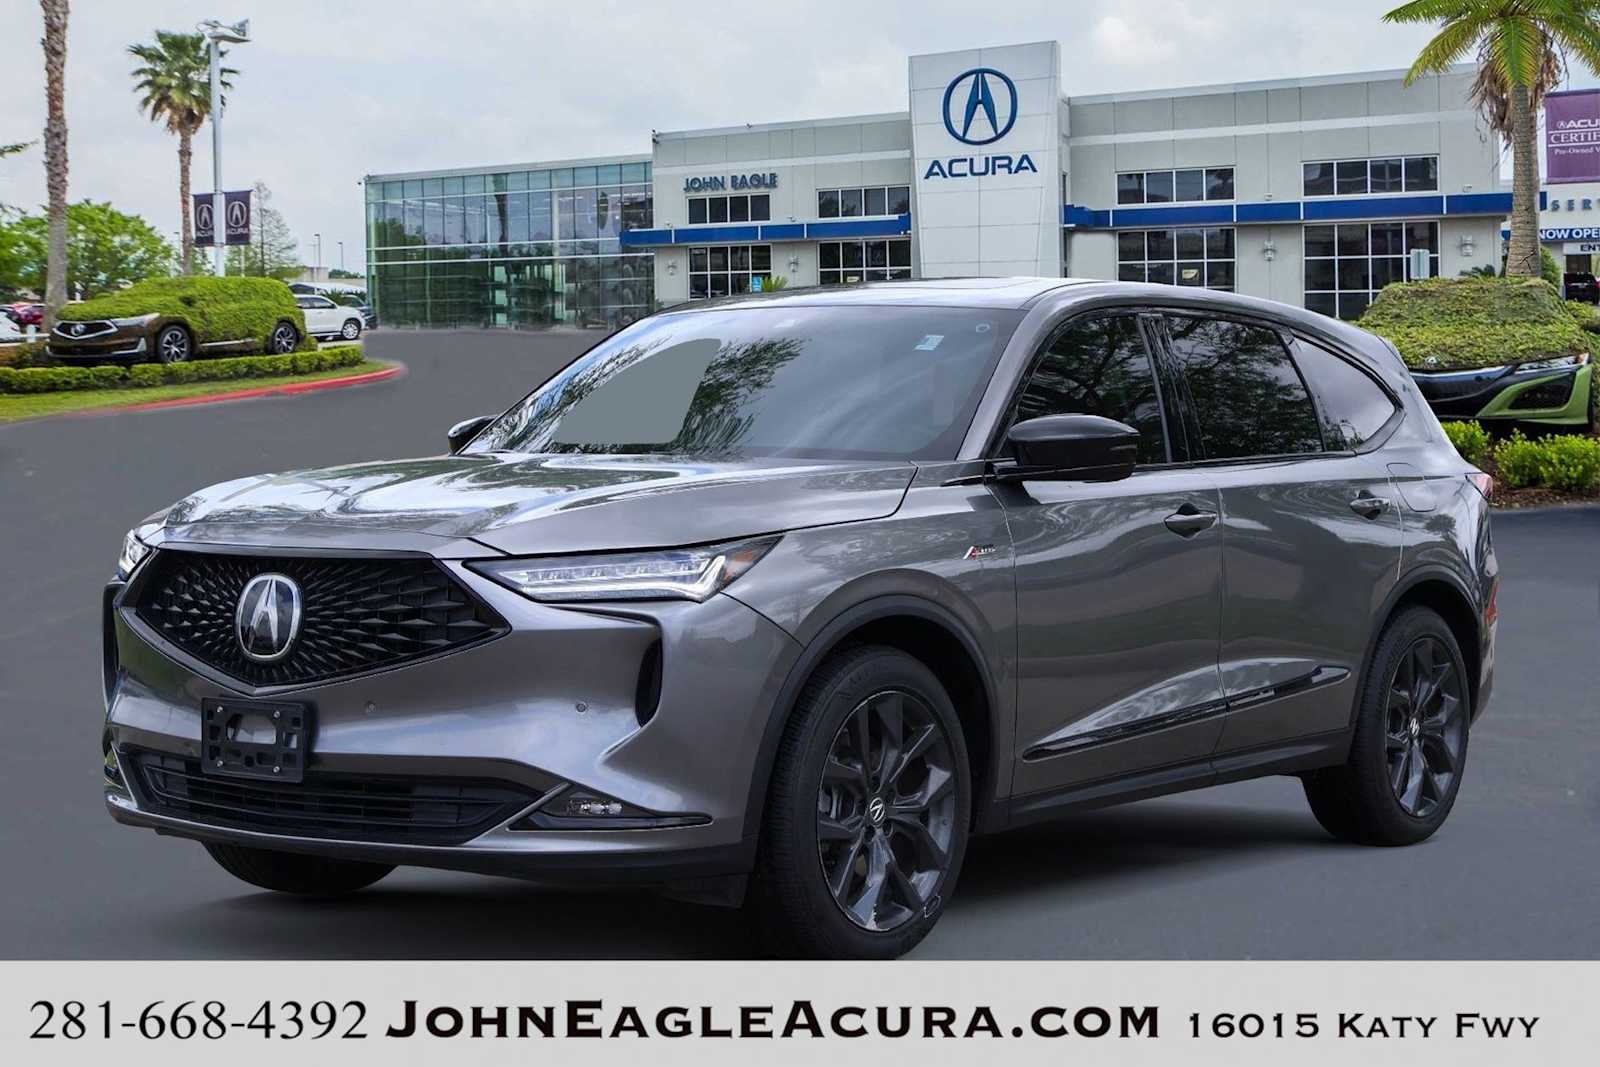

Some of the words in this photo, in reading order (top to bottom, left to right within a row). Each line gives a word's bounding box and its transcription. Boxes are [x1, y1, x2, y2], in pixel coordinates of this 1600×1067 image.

[1566, 119, 1600, 129] ACU
[923, 153, 1038, 180] ACURA
[683, 175, 726, 192] JOHN
[731, 173, 777, 191] EAGLE
[1551, 199, 1600, 211] SER
[1540, 229, 1570, 239] NOW
[1572, 228, 1600, 239] OPE
